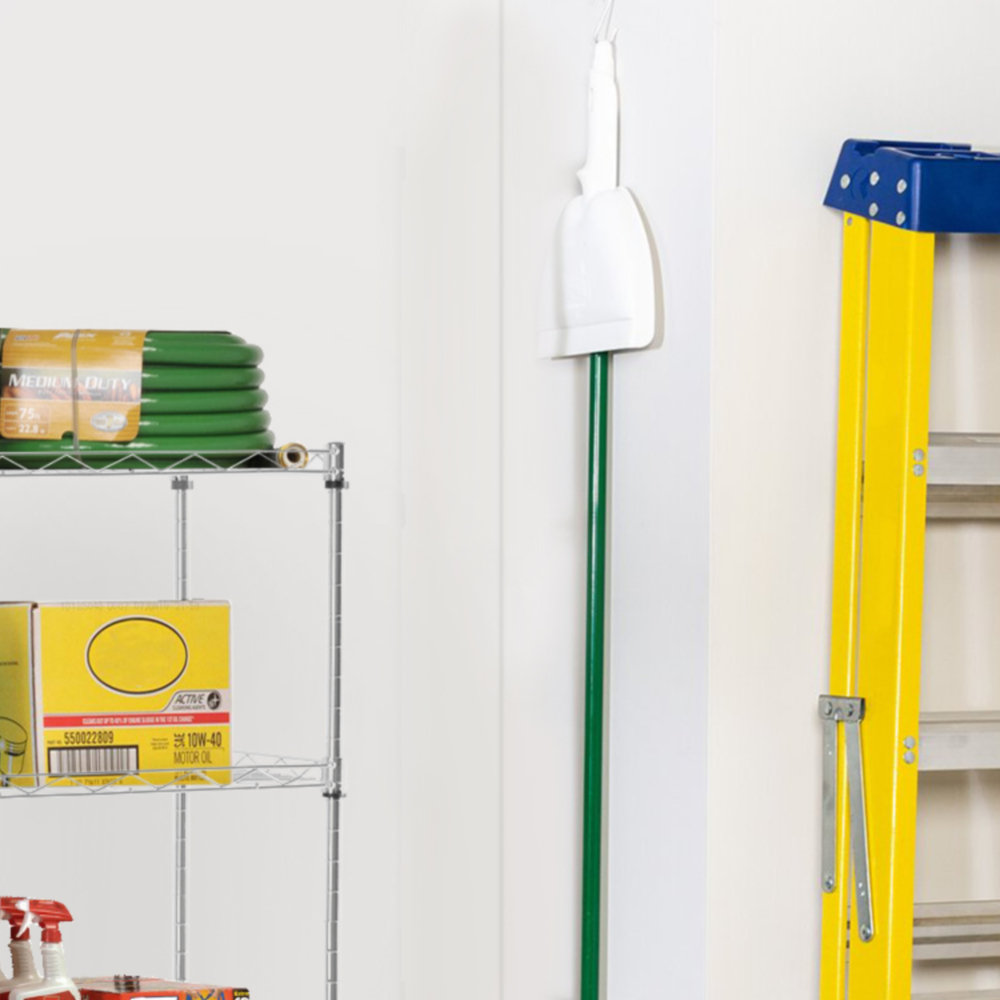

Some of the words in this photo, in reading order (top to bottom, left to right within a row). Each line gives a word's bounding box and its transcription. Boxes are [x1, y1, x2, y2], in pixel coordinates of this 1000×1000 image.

[84, 375, 131, 391] DUTY
[18, 407, 35, 420] 75
[174, 693, 206, 705] ACTIVE
[64, 731, 114, 745] 550022809
[187, 731, 222, 748] 10W-40
[173, 751, 199, 765] MOTOR
[200, 750, 213, 764] OIL
